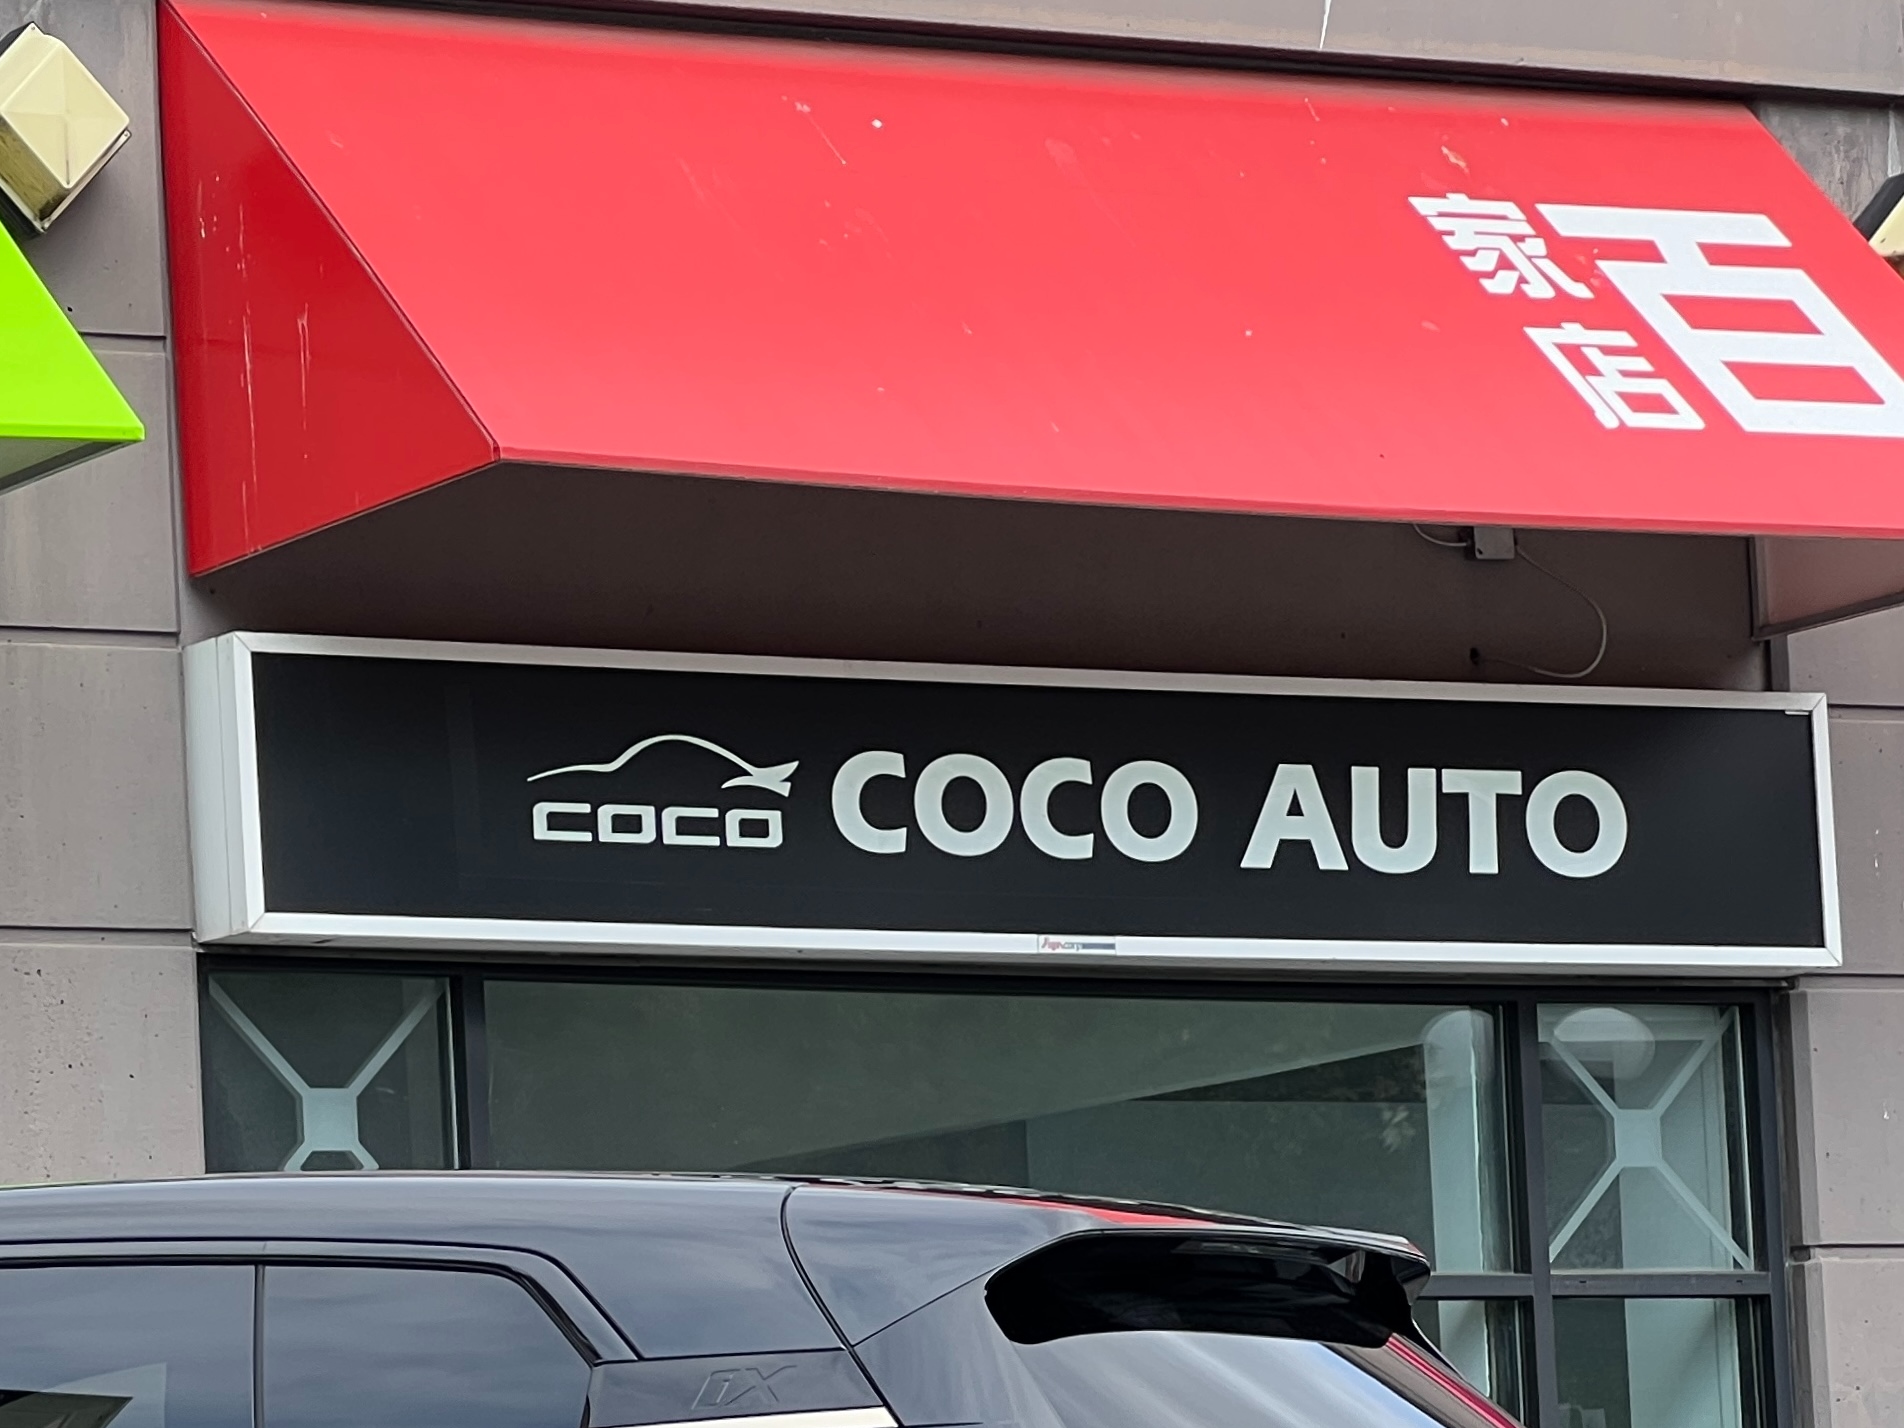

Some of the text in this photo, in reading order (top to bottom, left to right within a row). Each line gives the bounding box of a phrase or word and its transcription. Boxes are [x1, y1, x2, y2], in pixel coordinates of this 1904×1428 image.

[532, 801, 784, 848] COCO
[831, 750, 1628, 877] COCO AUTO
